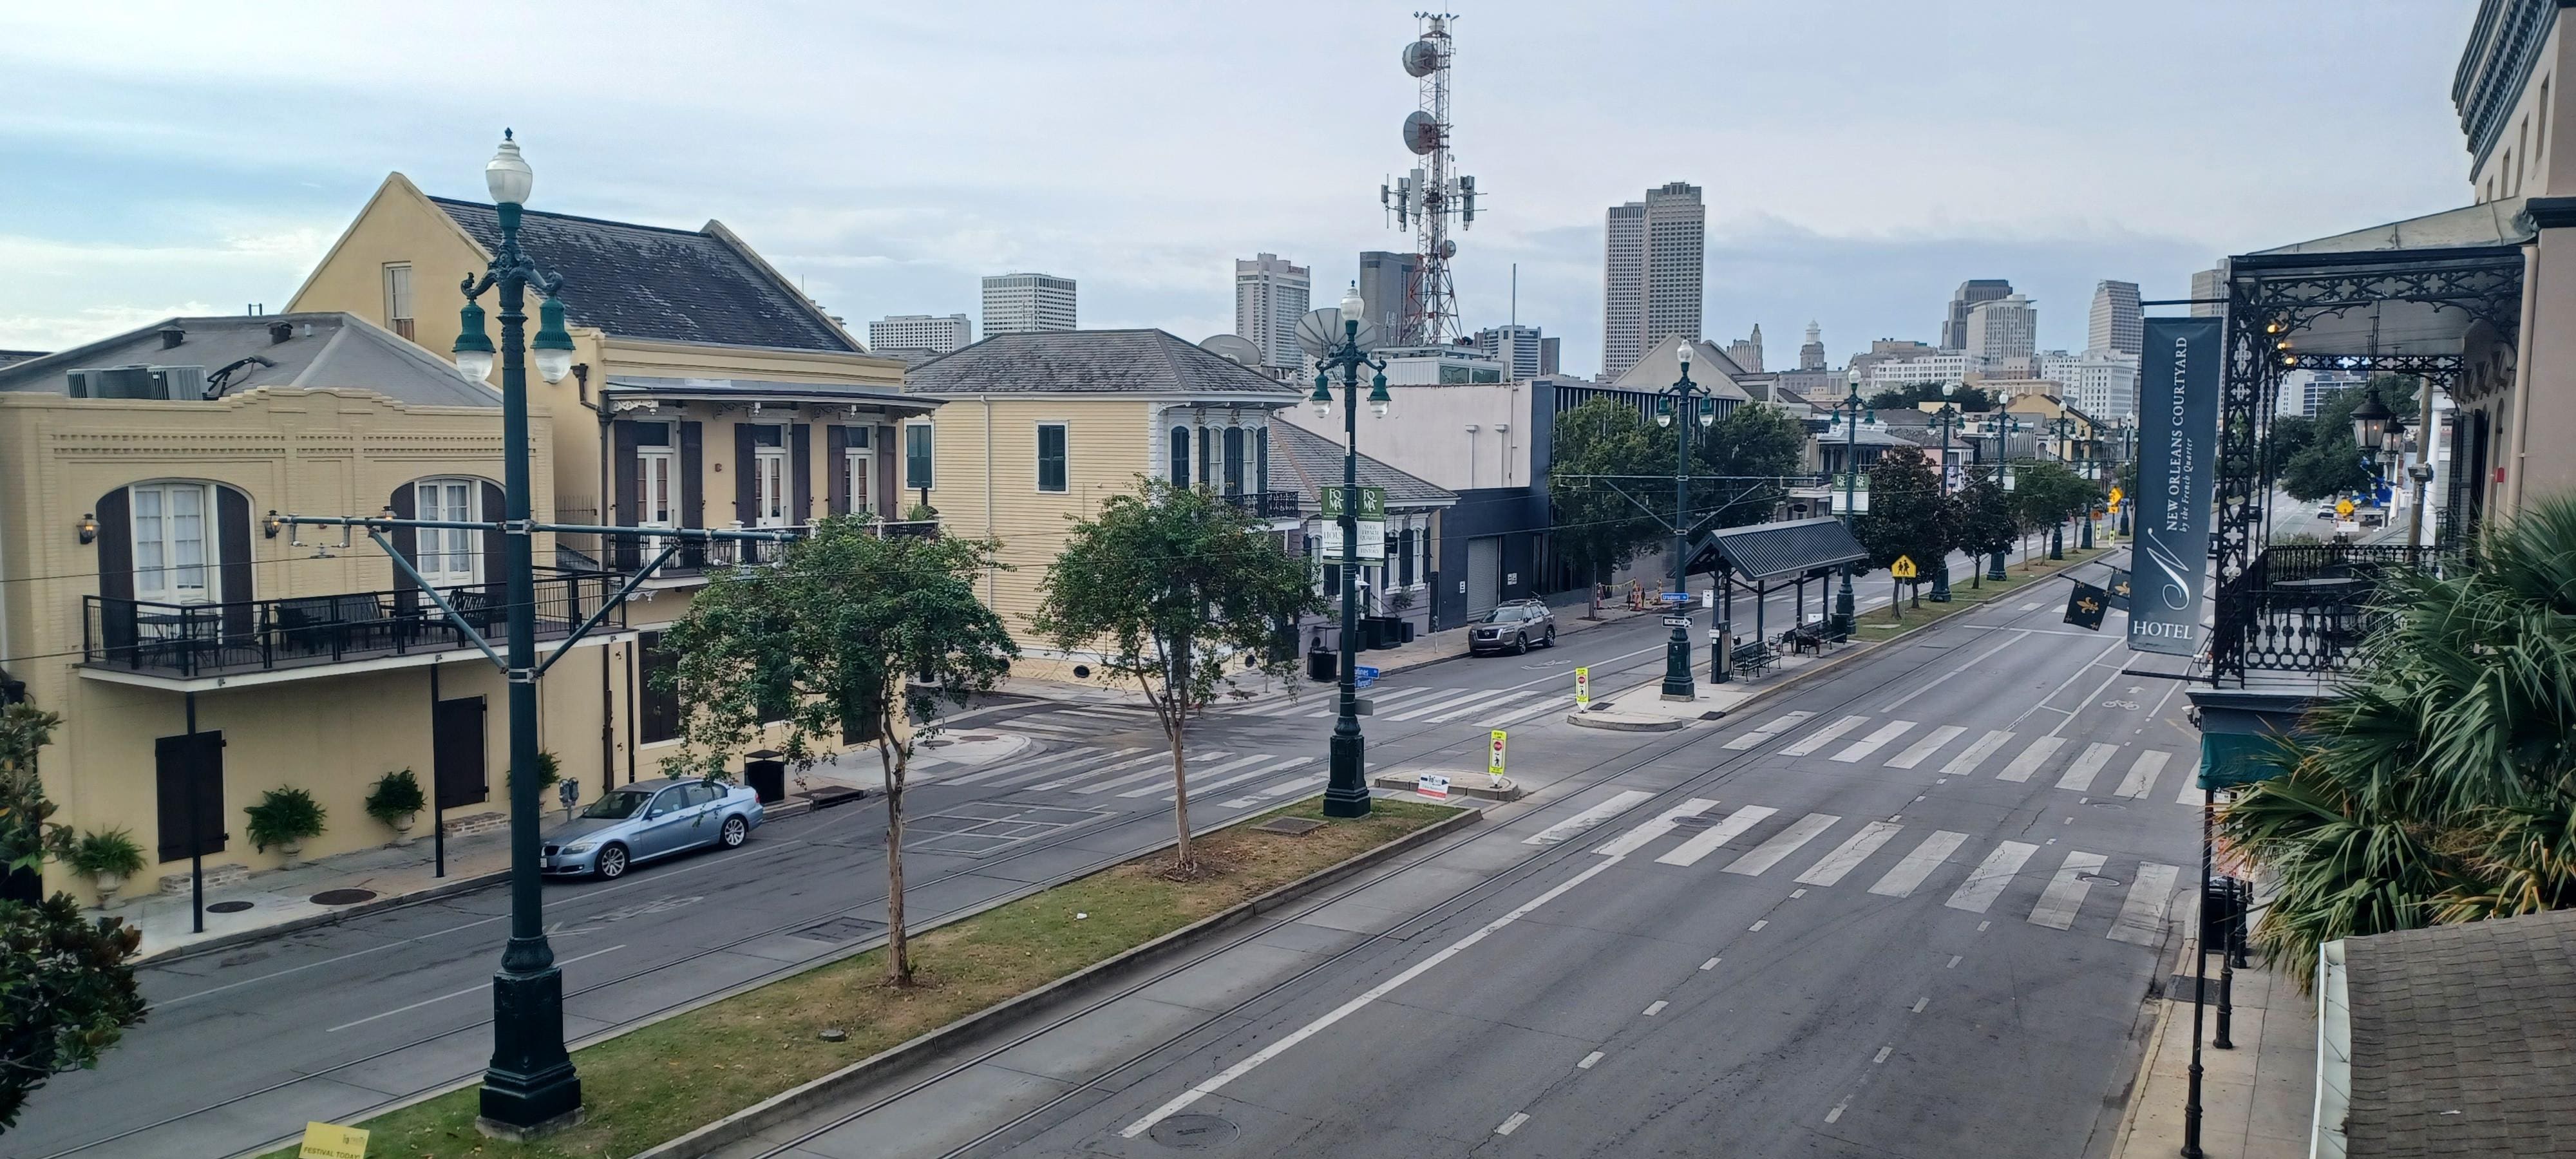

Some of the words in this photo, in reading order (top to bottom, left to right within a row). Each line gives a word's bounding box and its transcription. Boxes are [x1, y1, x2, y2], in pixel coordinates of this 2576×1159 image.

[2172, 337, 2188, 426] COURTYARD
[2168, 429, 2183, 495] ORLEANS
[2183, 438, 2193, 472] Quarter
[2182, 475, 2190, 504] French
[2166, 499, 2179, 531] NEW
[2179, 523, 2190, 532] by
[2181, 506, 2189, 520] the
[2133, 620, 2193, 639] HOTEL
[303, 1147, 334, 1157] FESTIVAL
